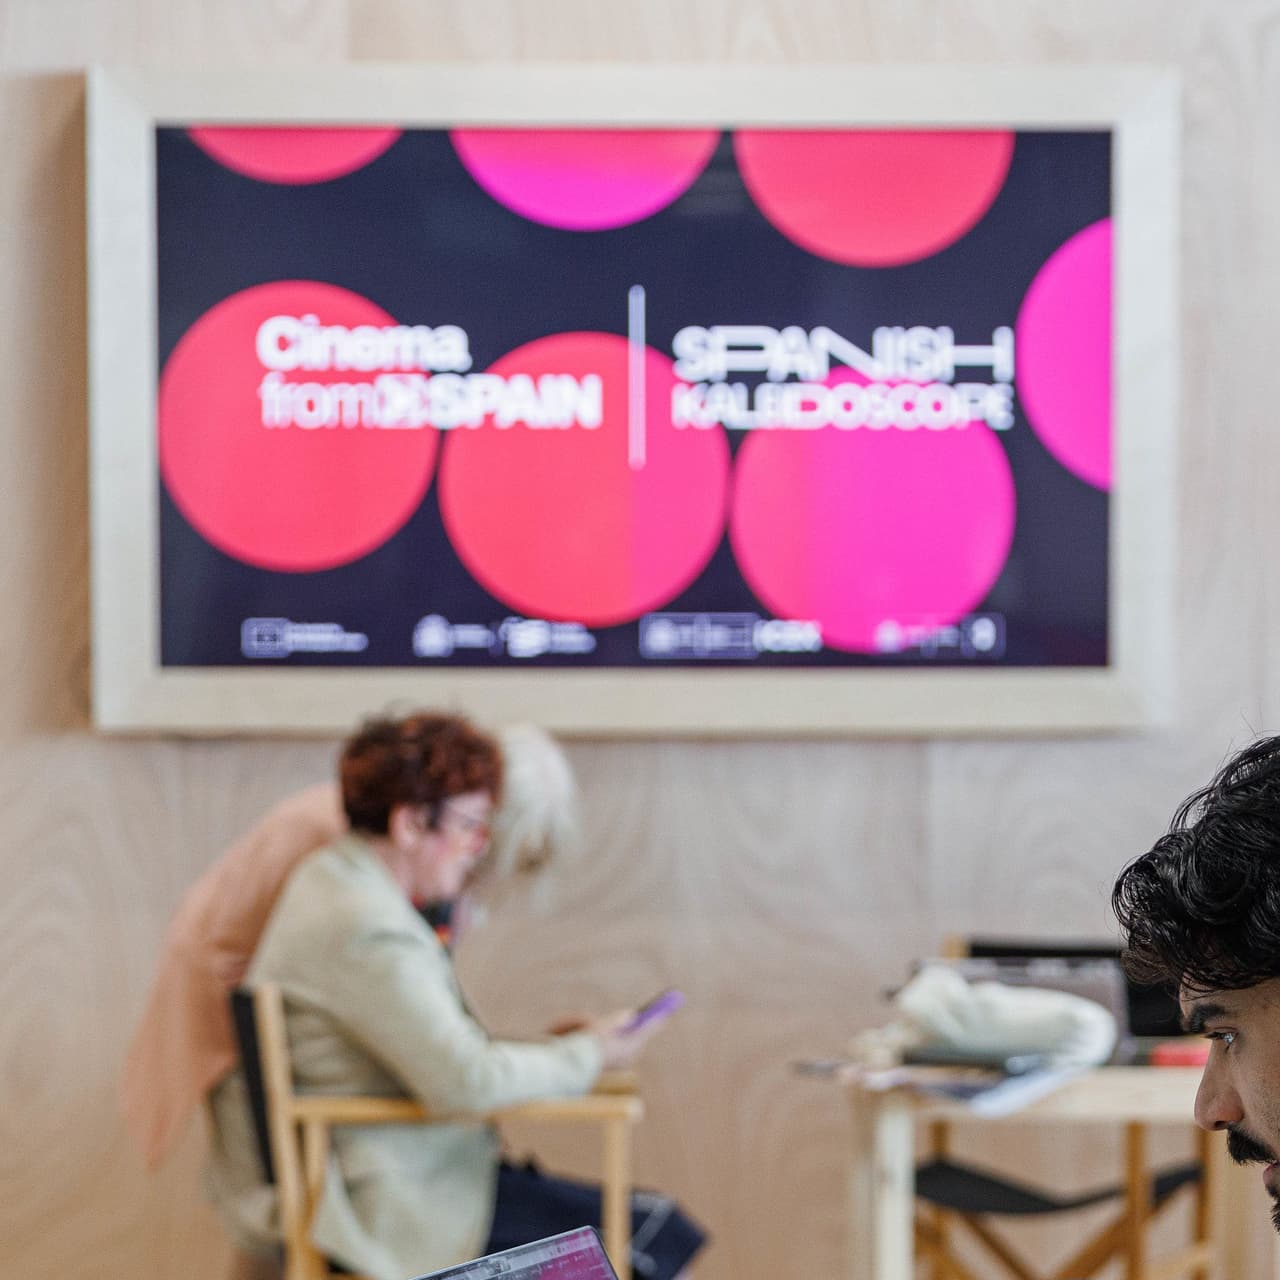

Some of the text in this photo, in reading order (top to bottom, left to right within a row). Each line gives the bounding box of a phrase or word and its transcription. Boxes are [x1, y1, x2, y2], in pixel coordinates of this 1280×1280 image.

[255, 314, 472, 373] Cinema
[673, 325, 1015, 381] SPANISH
[258, 371, 602, 429] from SPAIN
[672, 382, 1014, 430] KALEIDOSCOPE
